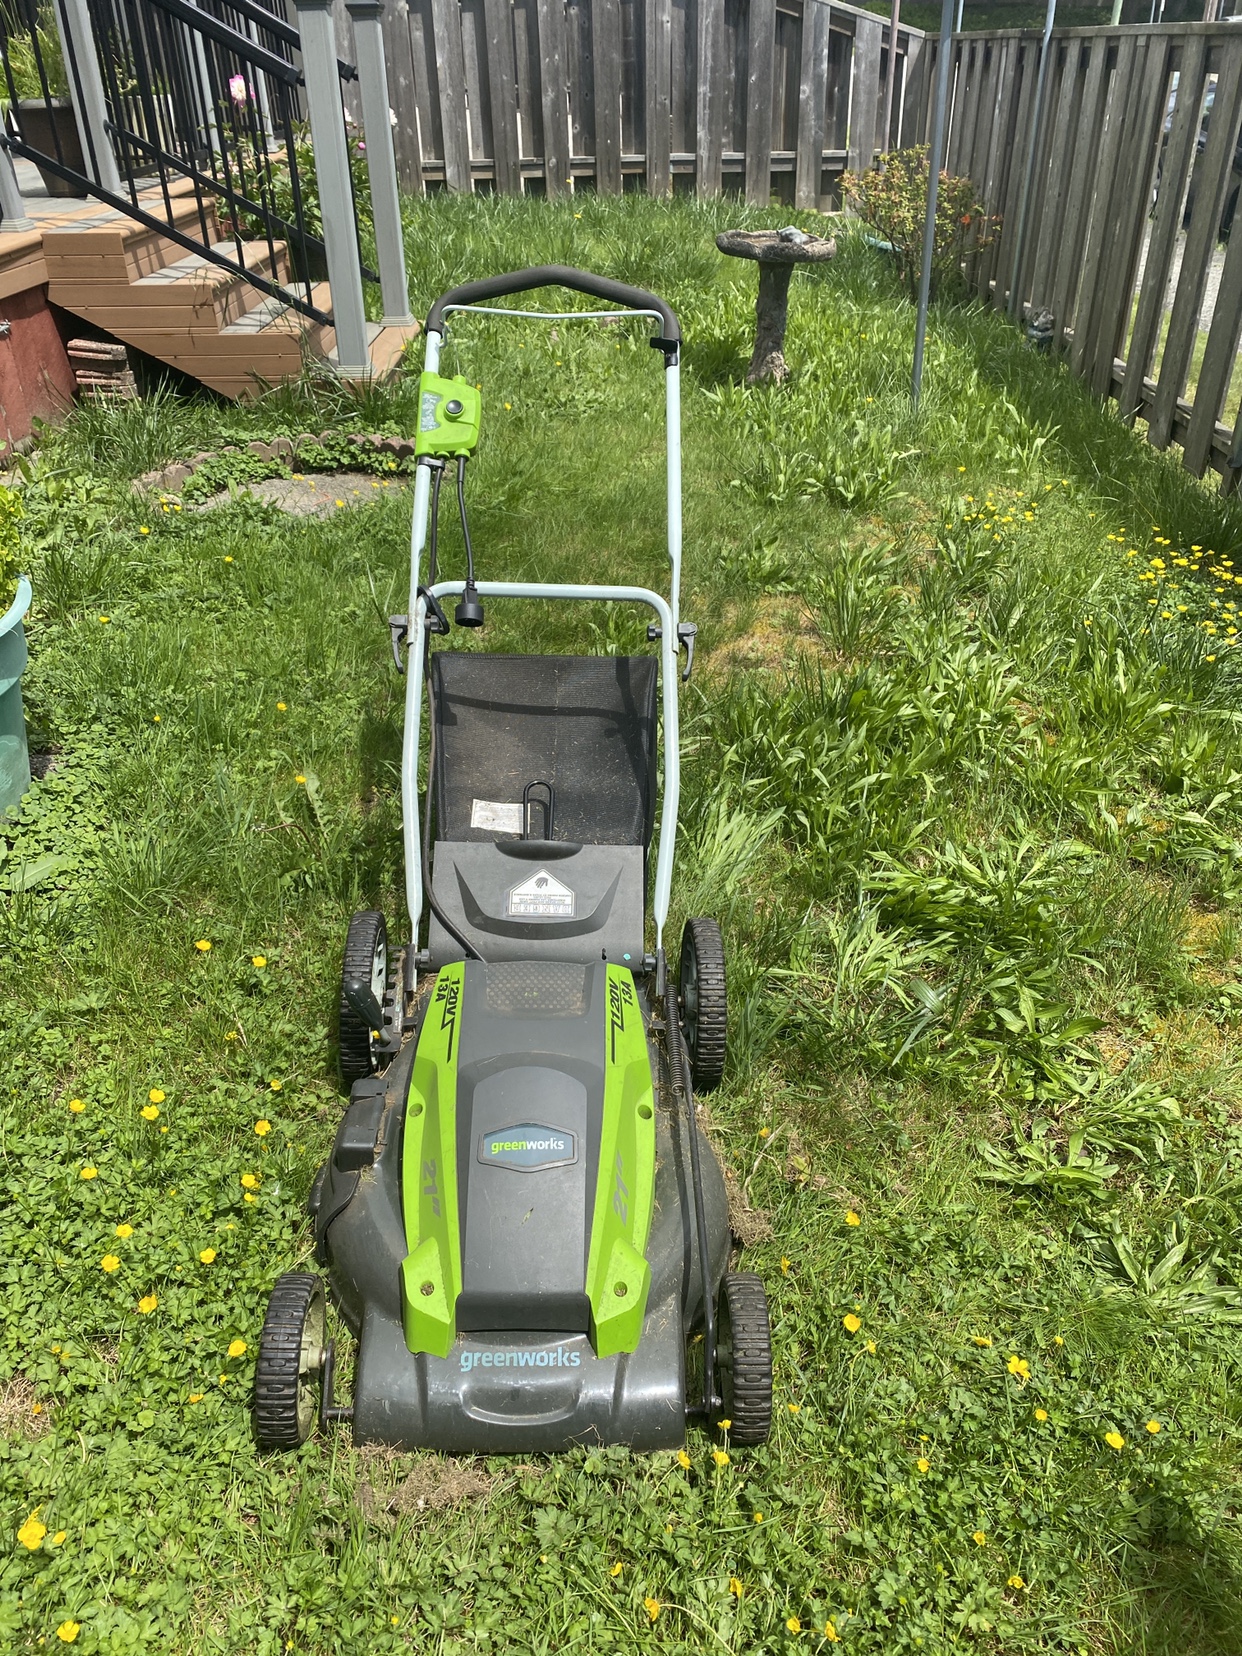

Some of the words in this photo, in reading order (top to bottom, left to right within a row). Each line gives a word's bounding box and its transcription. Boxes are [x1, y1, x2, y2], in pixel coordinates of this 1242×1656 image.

[435, 975, 450, 1003] 13A
[446, 977, 461, 1016] 120V
[608, 976, 621, 1021] 120V
[621, 980, 634, 1007] 13A
[491, 1137, 564, 1154] greenworks
[460, 1347, 581, 1372] greenworks
